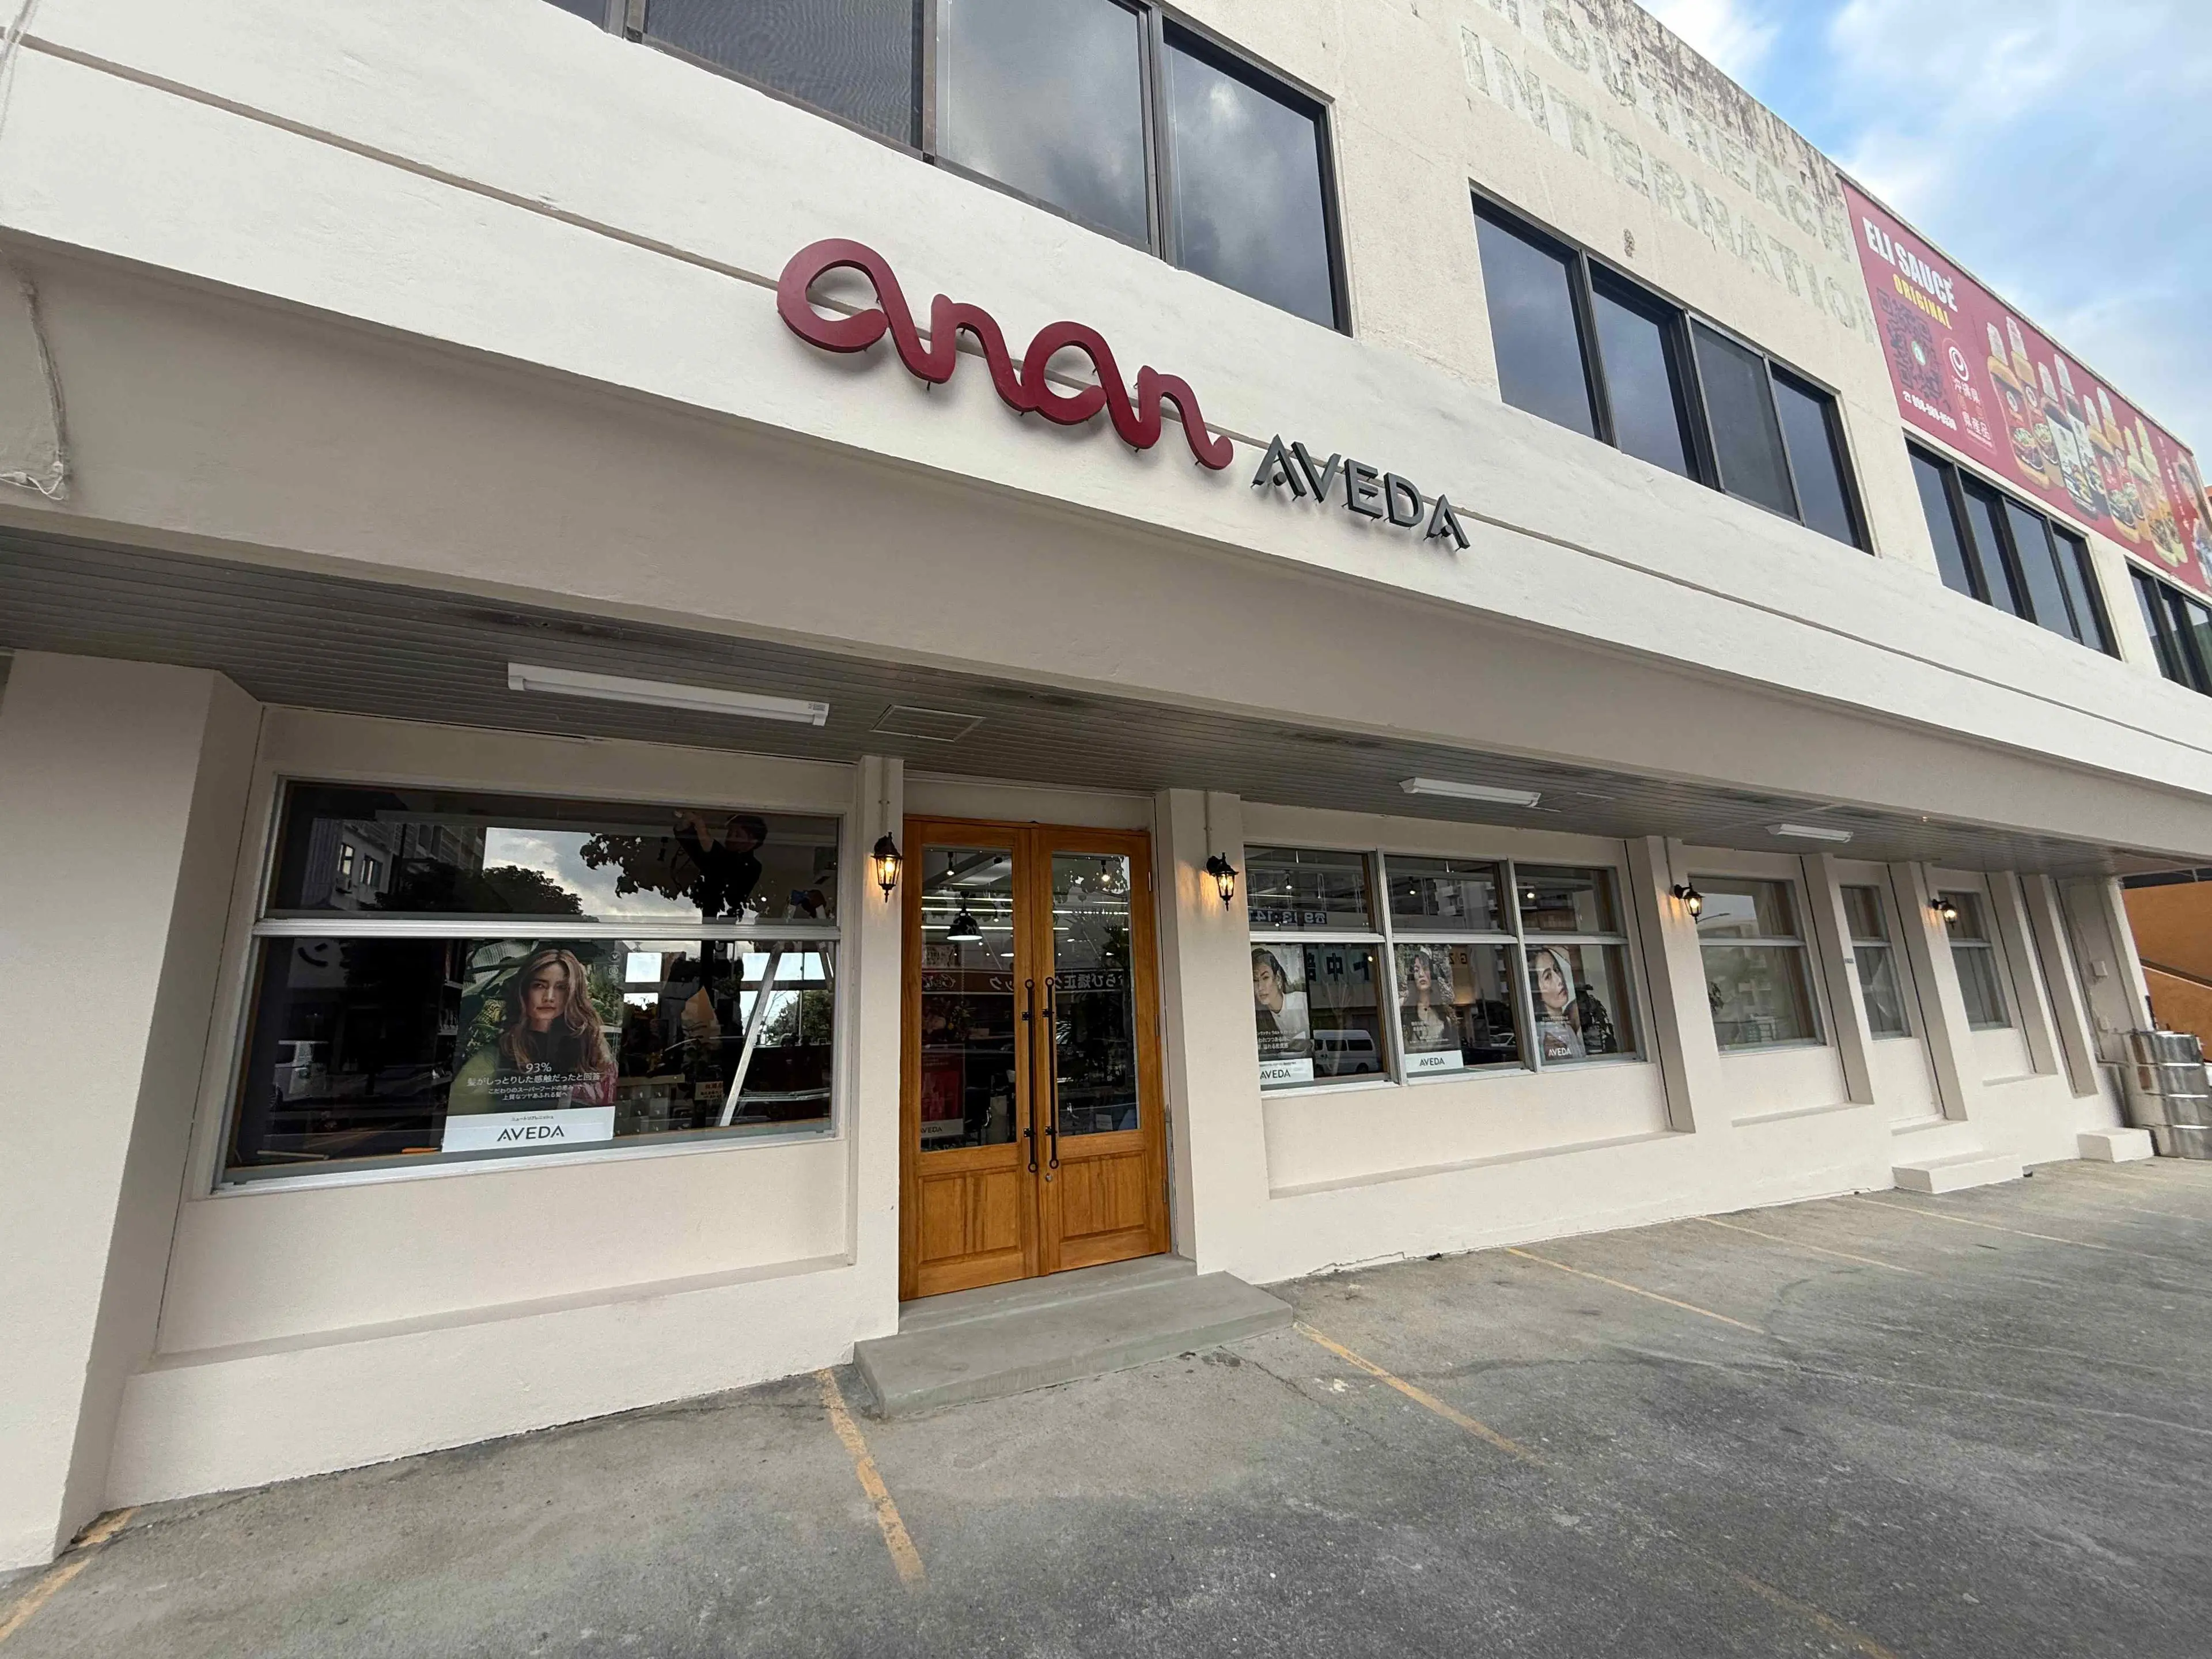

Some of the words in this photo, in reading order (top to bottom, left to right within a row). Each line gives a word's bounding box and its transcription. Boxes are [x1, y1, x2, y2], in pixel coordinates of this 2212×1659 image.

[1862, 217, 1895, 266] ELI
[1894, 242, 1957, 313] SAUCE
[1893, 274, 1952, 331] ORIGINAL
[777, 237, 1234, 471] anan
[1252, 433, 1471, 551] AVEDA
[1548, 1048, 1572, 1057] AVEDA
[525, 1062, 552, 1073] 93%
[1419, 1057, 1445, 1066] AVEDA
[1260, 1069, 1291, 1080] AVEDA
[497, 1125, 565, 1142] AVEDA
